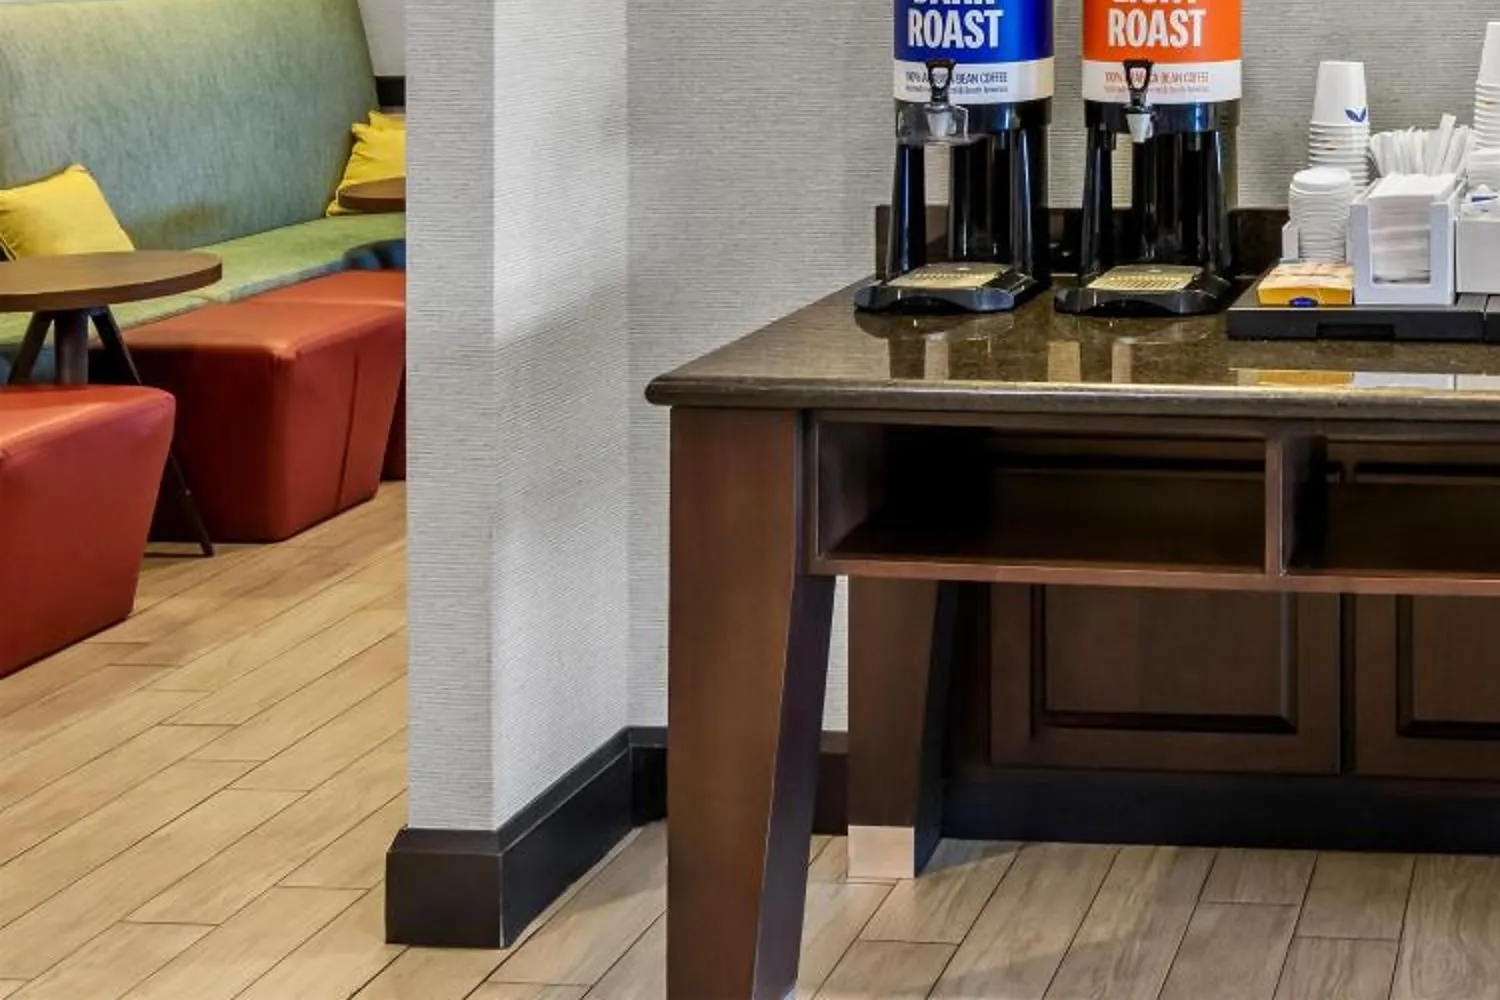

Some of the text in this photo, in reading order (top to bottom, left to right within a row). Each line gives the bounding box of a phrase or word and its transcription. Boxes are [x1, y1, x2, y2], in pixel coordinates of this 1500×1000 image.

[907, 8, 1003, 49] ROAST
[1108, 8, 1206, 47] ROAST
[980, 71, 1008, 84] COFFEE
